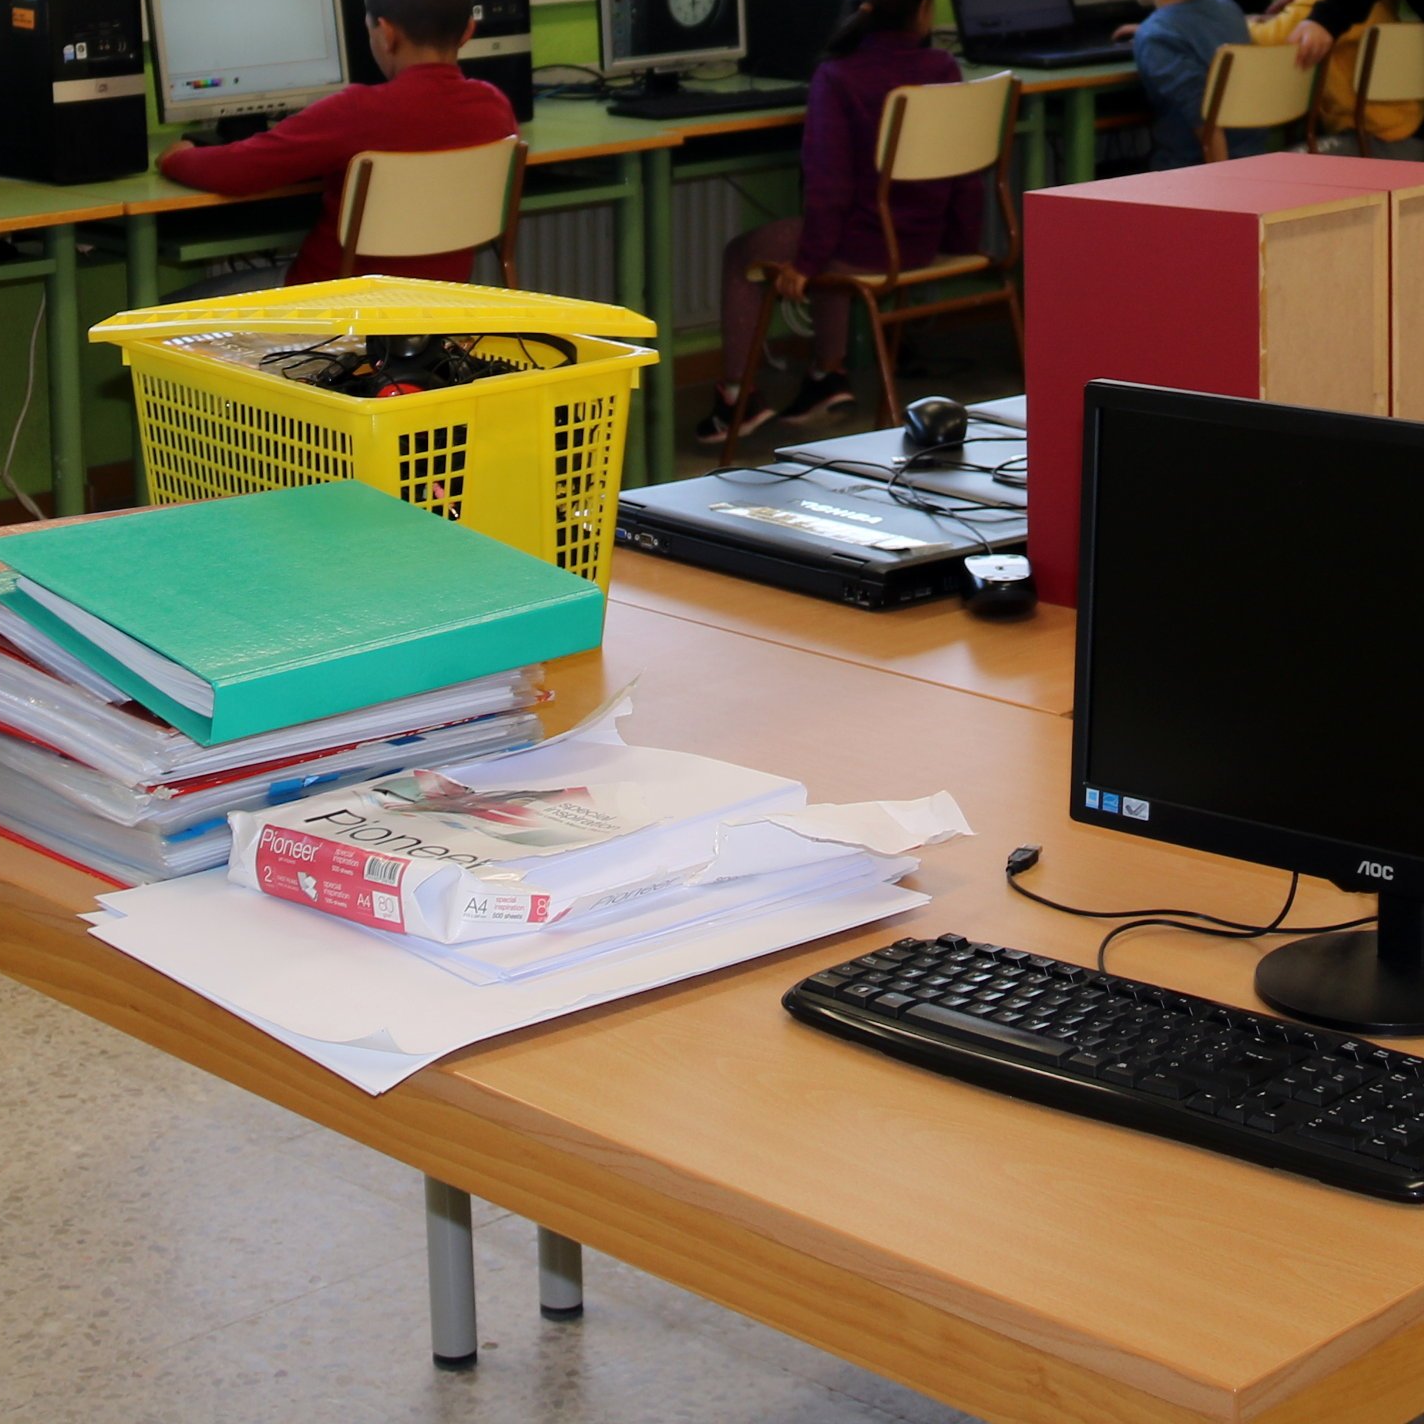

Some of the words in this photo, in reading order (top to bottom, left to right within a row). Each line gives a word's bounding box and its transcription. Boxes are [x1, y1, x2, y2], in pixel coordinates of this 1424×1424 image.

[259, 828, 320, 862] Pioneer
[304, 809, 494, 869] Pioneer
[263, 866, 273, 883] 2
[1357, 860, 1394, 880] AOC
[356, 893, 371, 908] A4
[378, 895, 394, 914] 80
[464, 897, 488, 914] A4
